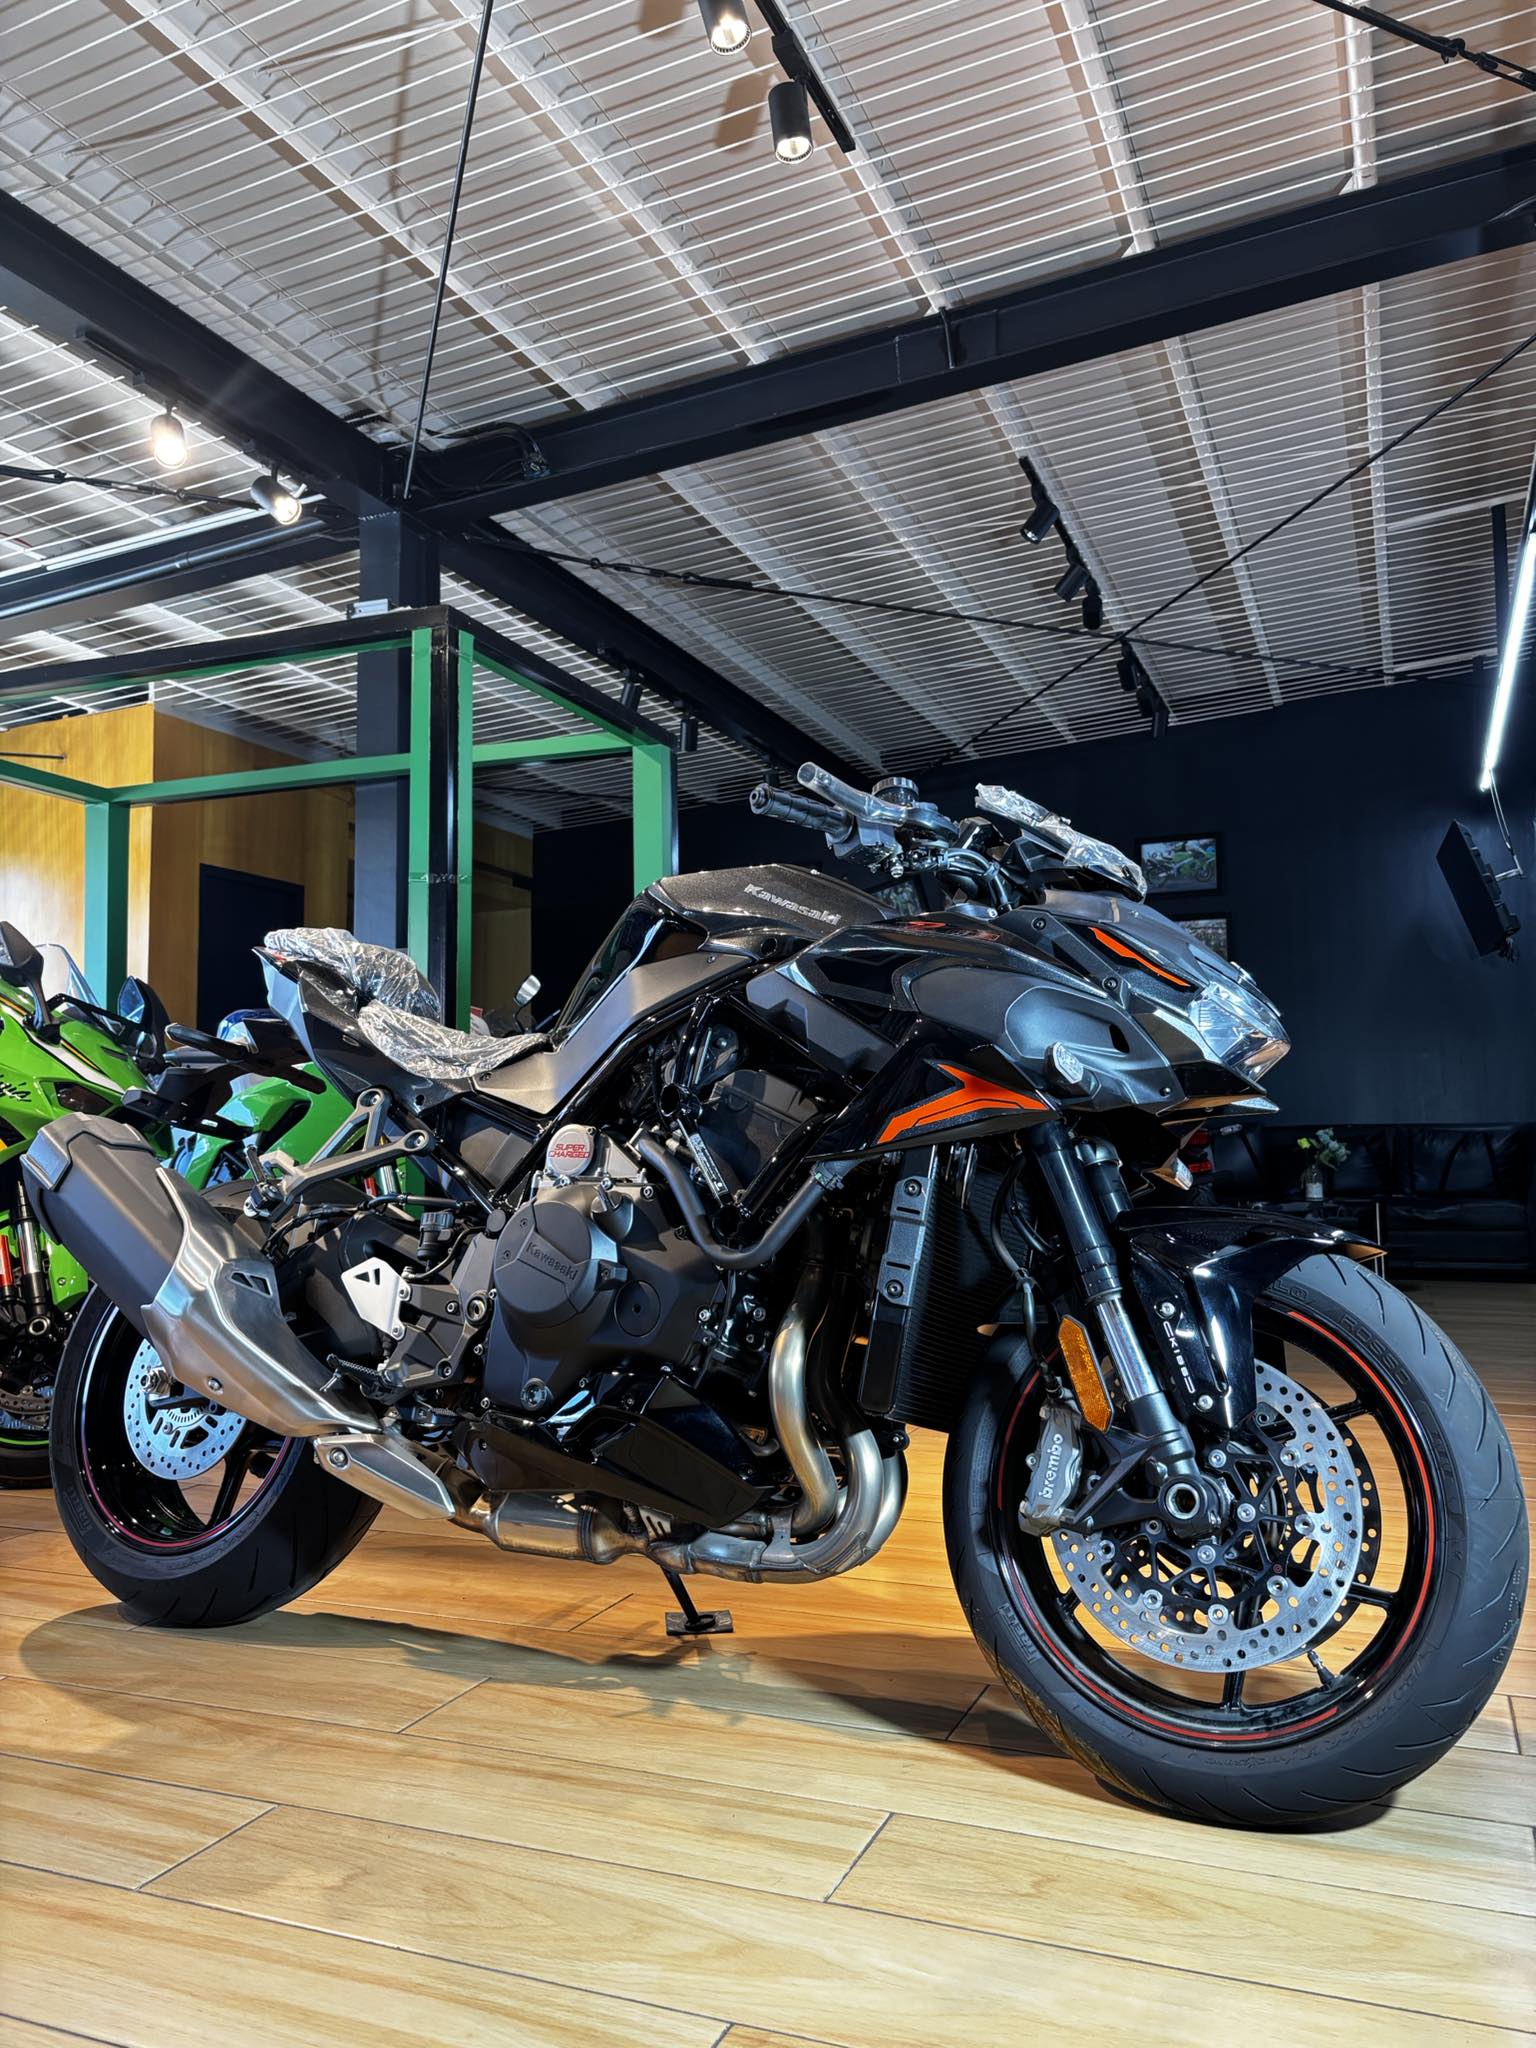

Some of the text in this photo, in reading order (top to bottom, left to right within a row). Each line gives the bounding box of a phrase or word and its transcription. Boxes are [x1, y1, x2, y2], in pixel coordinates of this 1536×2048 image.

[743, 883, 842, 926] Kawasaki
[554, 1143, 585, 1151] SUPER
[525, 1241, 579, 1281] Kawasaki
[1039, 1433, 1063, 1499] brembo
